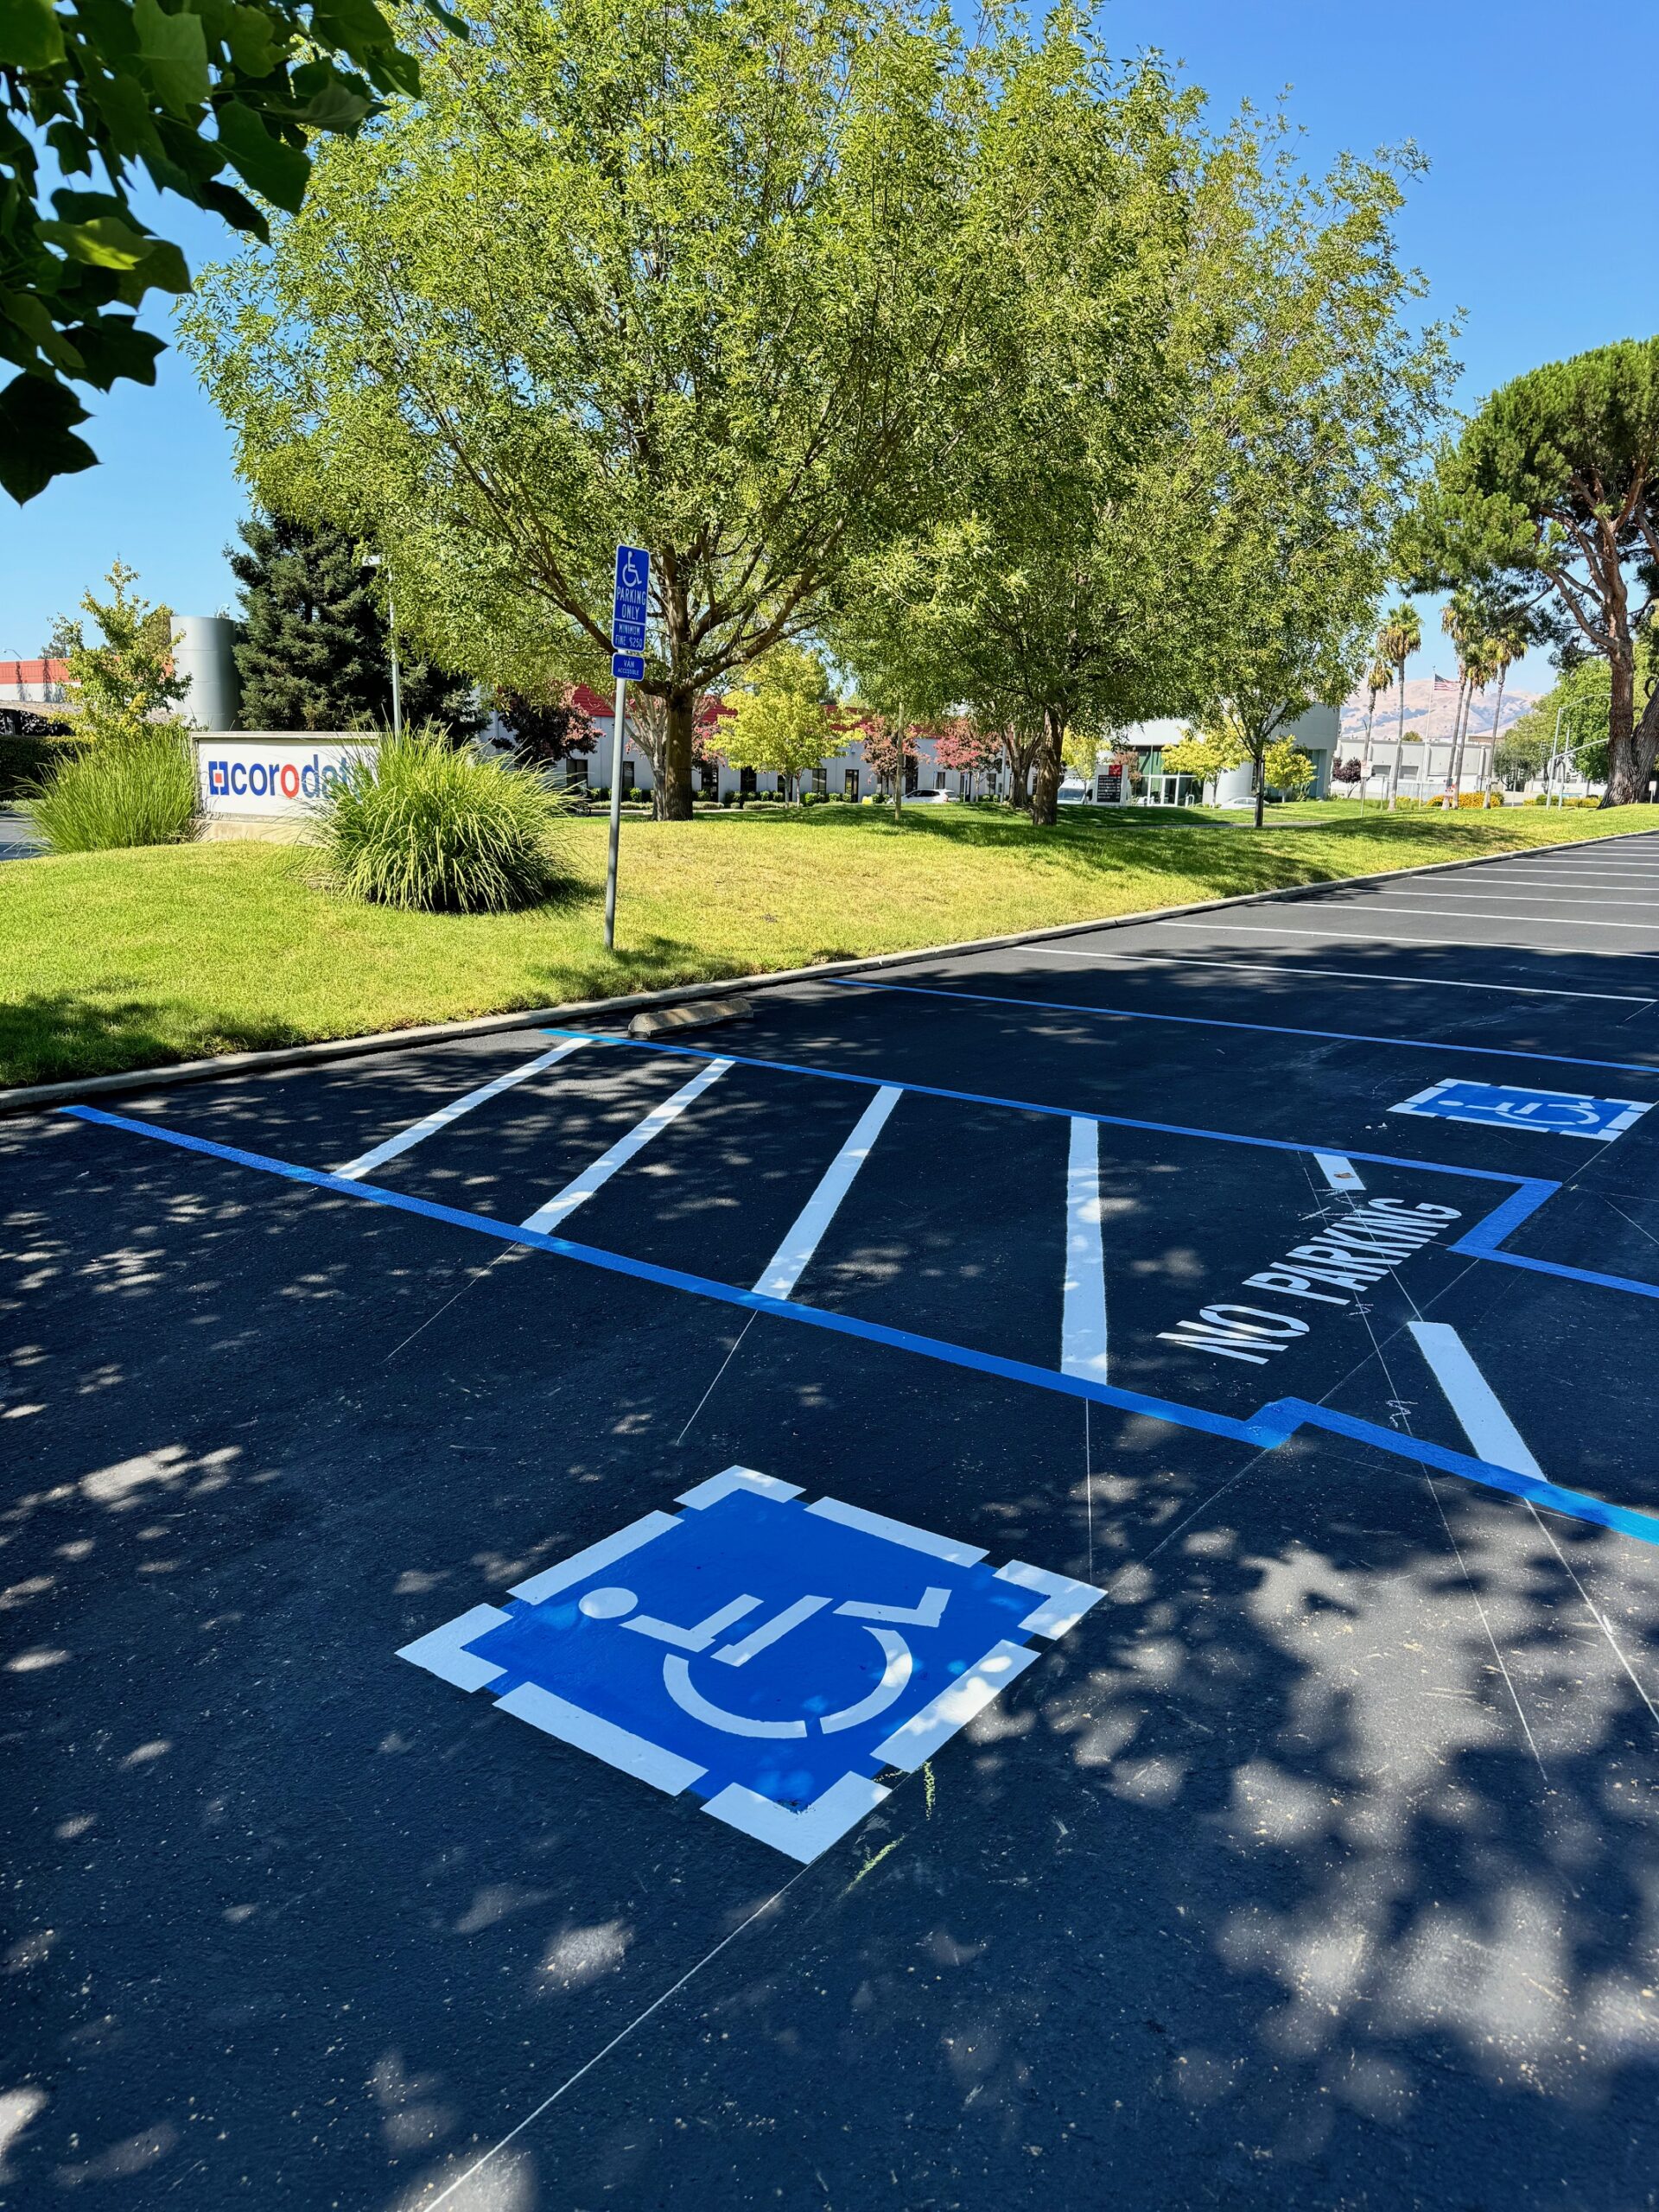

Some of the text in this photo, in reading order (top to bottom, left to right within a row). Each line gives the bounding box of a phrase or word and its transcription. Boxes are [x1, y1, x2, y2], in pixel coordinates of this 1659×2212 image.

[616, 587, 646, 605] PARKING
[621, 604, 639, 620] ONLY
[619, 623, 640, 636] MINIMUM
[615, 635, 643, 648] FINE $250
[624, 659, 634, 668] VAN
[231, 754, 363, 800] corodat
[1155, 1198, 1462, 1365] NO PARKING
